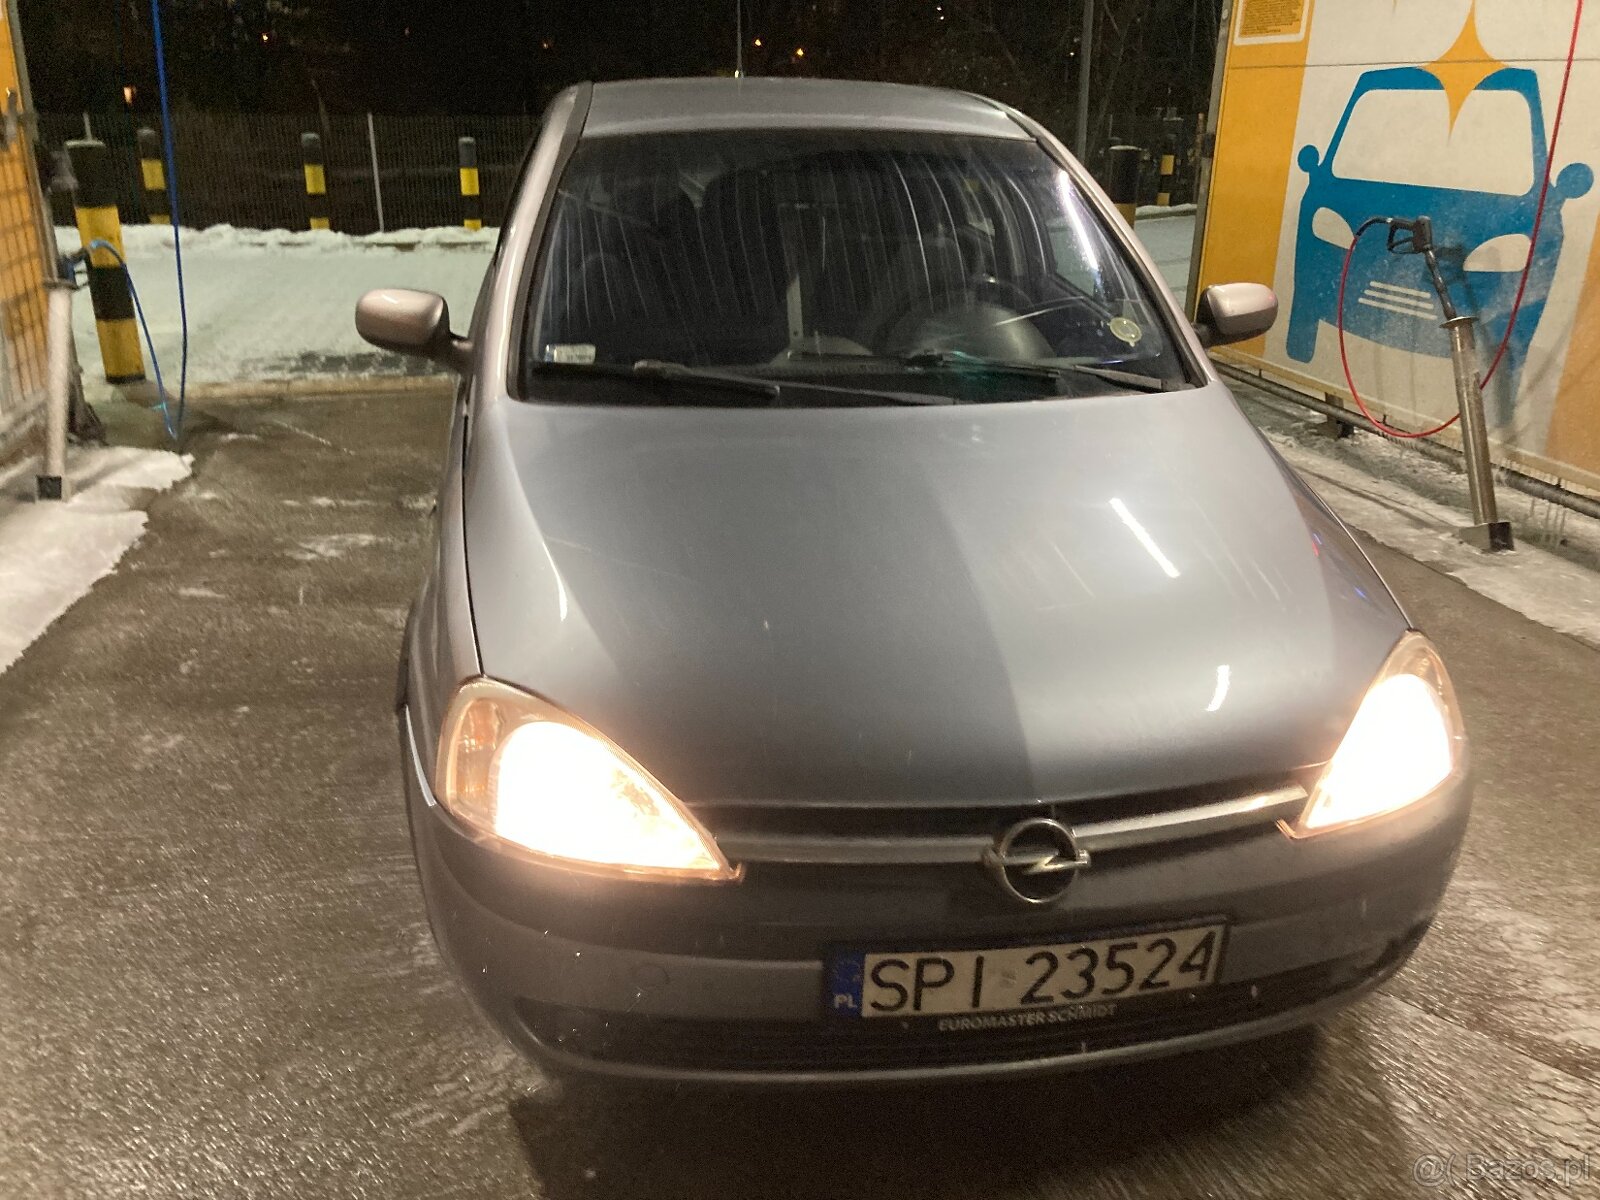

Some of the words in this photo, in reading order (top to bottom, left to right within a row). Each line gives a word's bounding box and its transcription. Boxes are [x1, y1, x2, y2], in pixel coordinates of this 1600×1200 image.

[870, 954, 985, 1012] SPI
[1019, 930, 1217, 1006] 23524
[834, 993, 858, 1009] PL
[938, 1011, 1045, 1032] EUROMASTER
